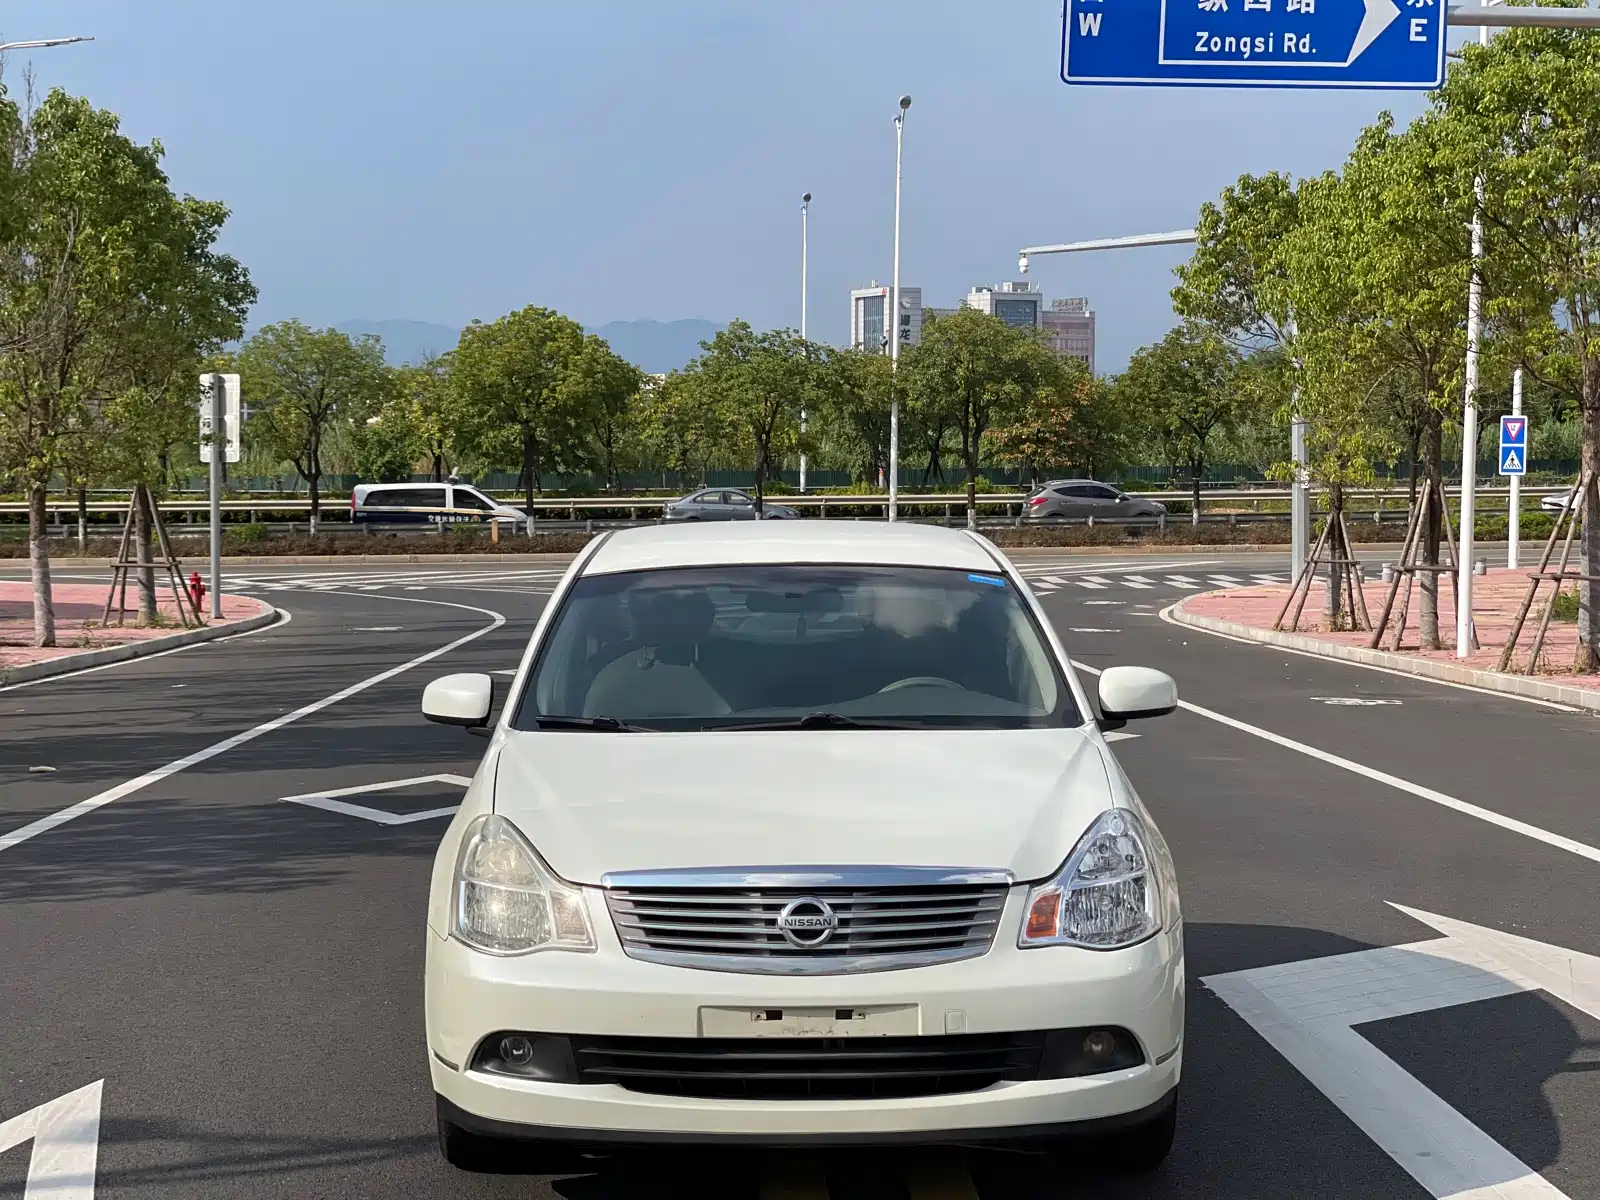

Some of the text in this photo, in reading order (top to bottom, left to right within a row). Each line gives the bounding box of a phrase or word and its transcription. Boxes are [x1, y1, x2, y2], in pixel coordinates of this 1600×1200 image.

[1078, 12, 1103, 37] W
[1409, 18, 1428, 42] E
[1194, 31, 1317, 59] Zongsi Rd.
[784, 918, 832, 927] NISSAN
